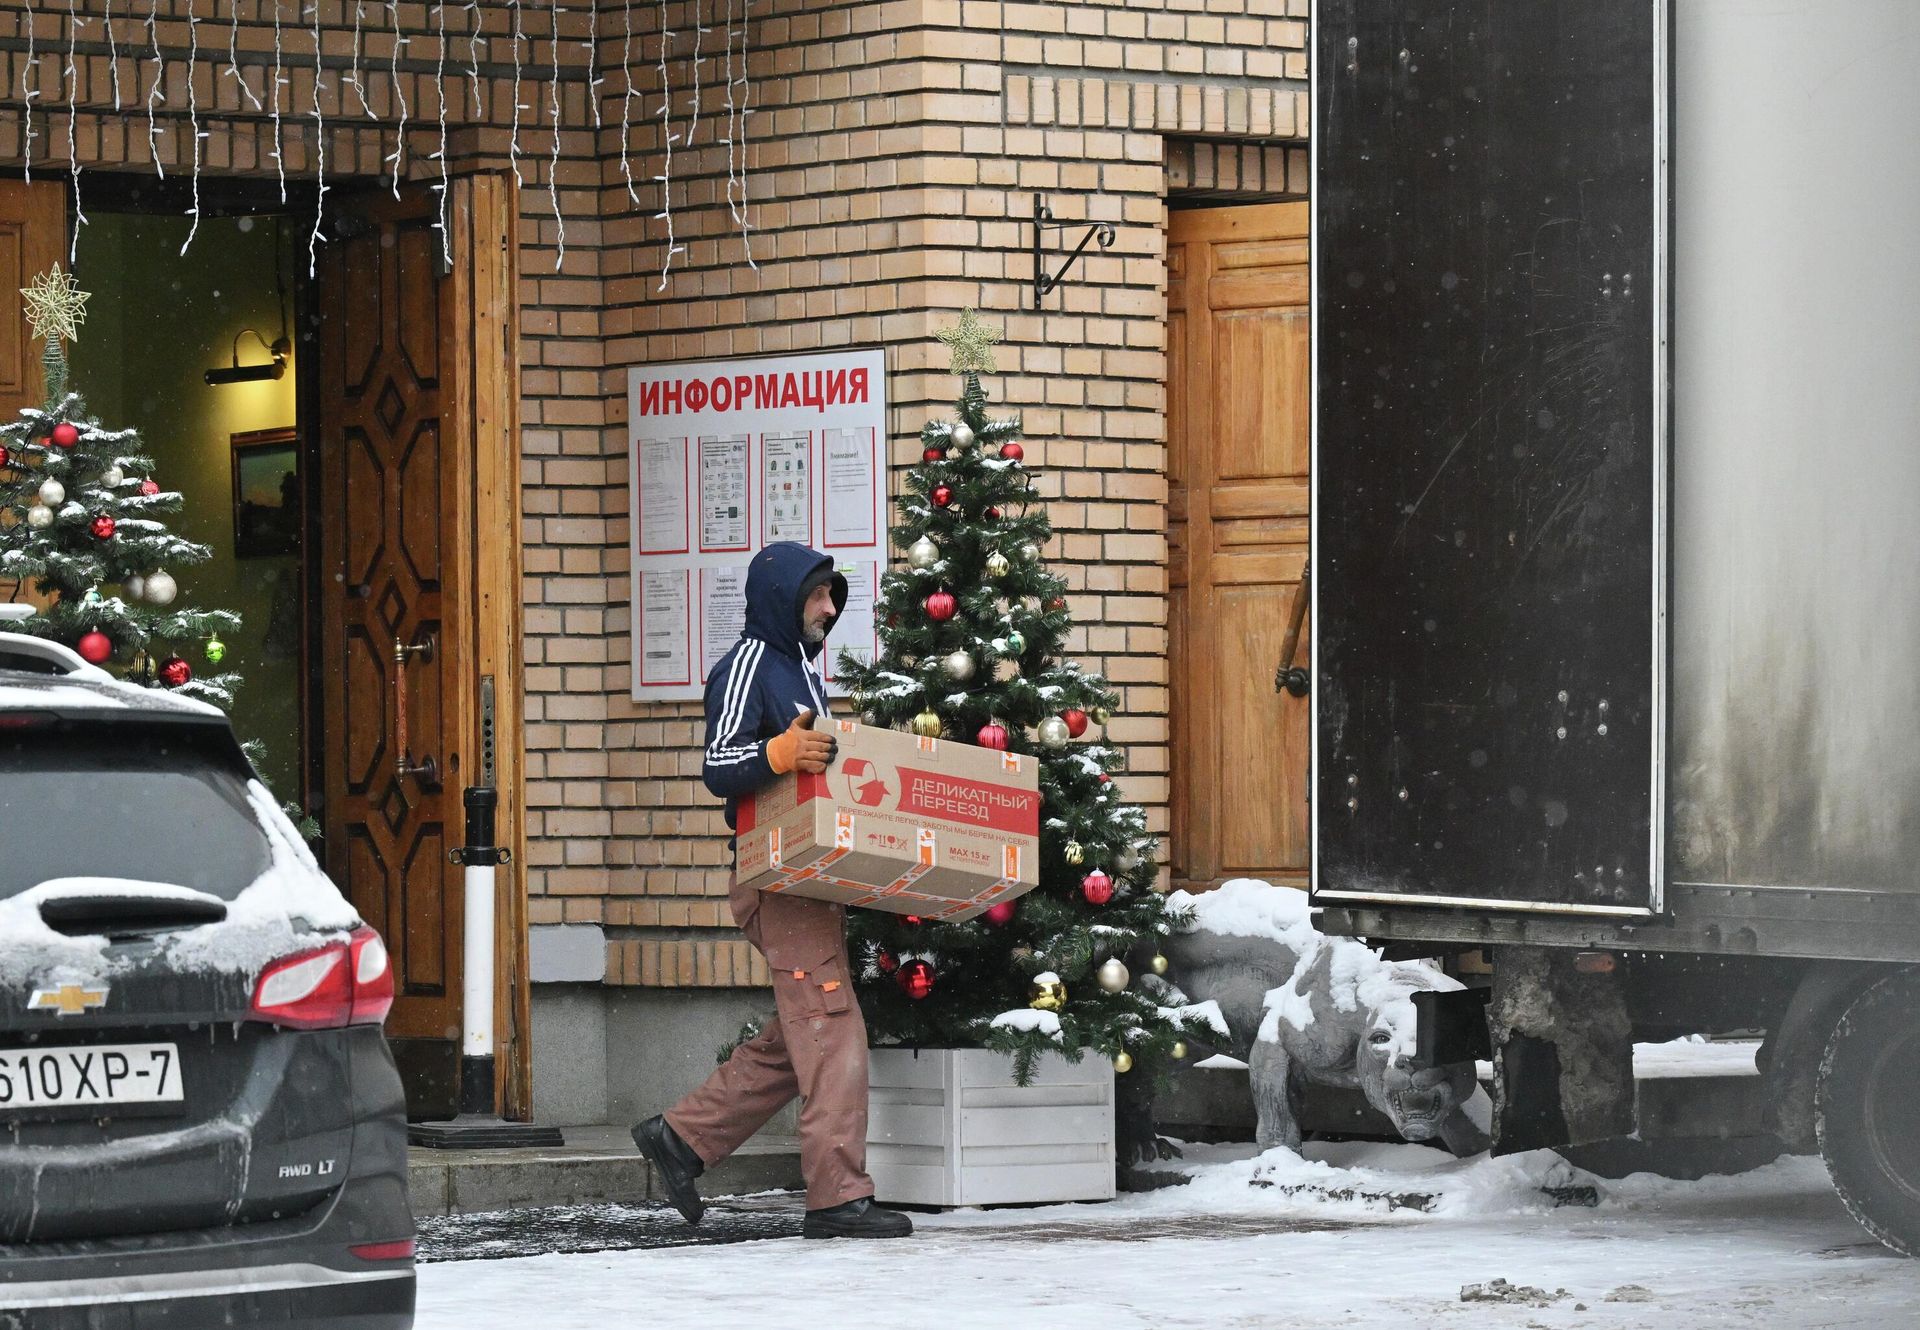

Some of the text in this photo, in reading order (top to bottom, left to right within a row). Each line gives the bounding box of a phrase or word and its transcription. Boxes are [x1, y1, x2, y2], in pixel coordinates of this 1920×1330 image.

[640, 368, 868, 416] ИНФОРМАЦИЯ
[912, 793, 989, 822] ПЕРЕЕЗД
[971, 851, 980, 859] 15
[278, 1159, 335, 1178] AWD LT
